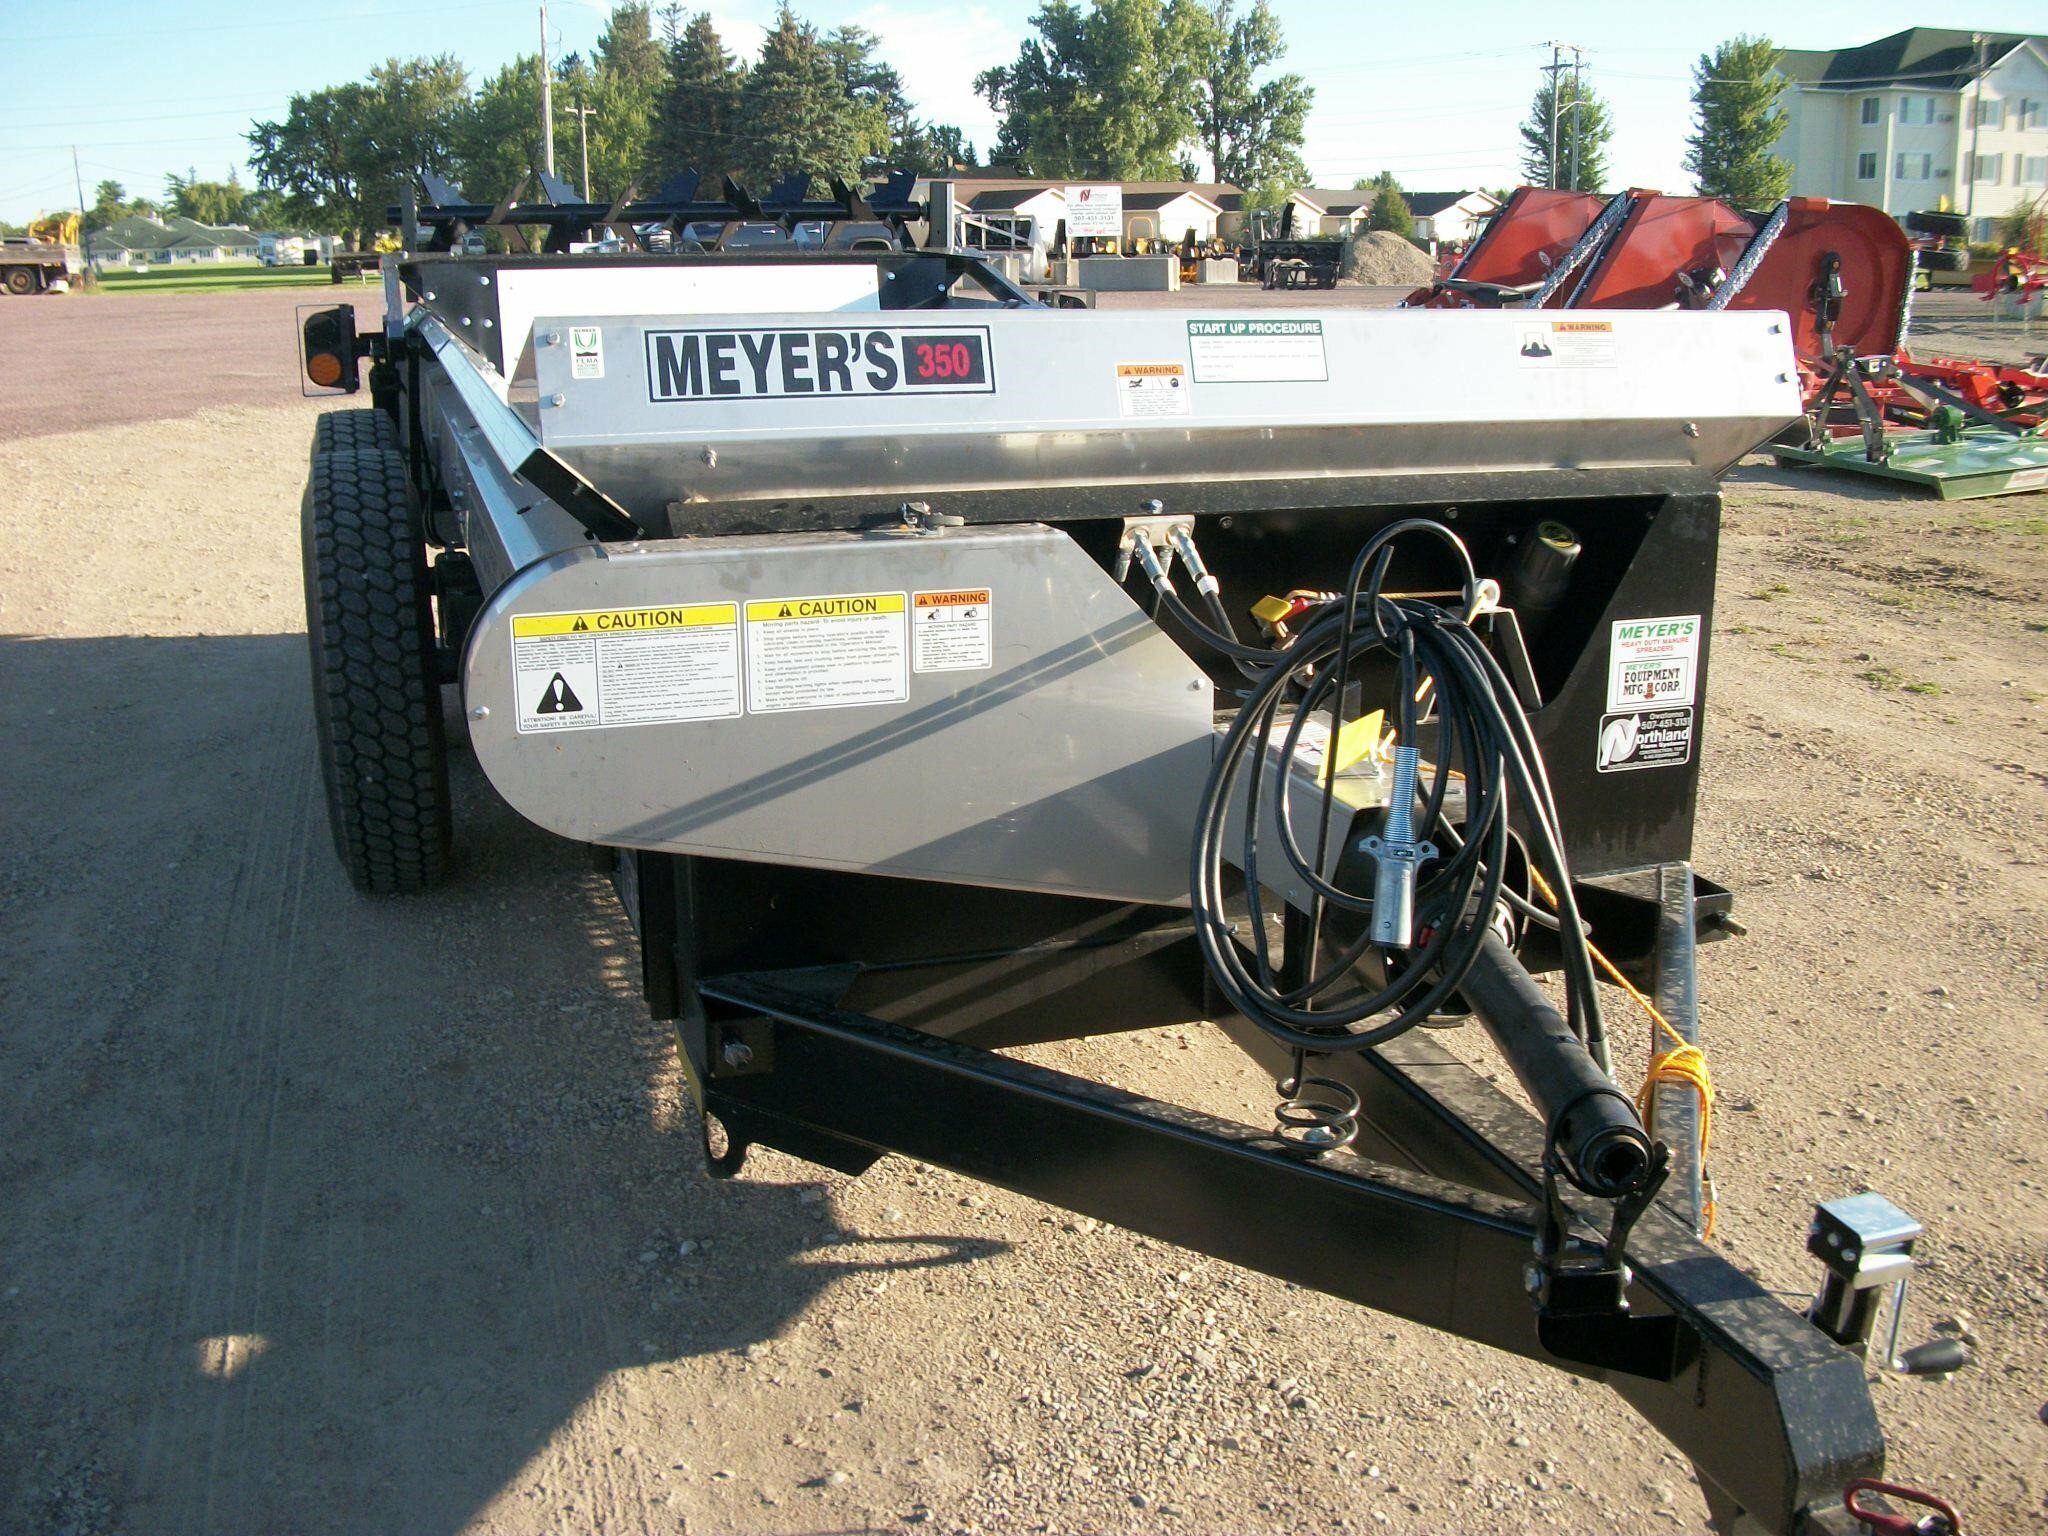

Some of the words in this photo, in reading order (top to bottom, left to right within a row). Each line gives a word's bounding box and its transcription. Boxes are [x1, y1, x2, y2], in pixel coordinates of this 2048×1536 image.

[1189, 323, 1227, 334] START
[1229, 323, 1246, 334] UP
[1248, 322, 1320, 334] PROCEDURE
[1567, 323, 1607, 331] WARNING
[655, 330, 899, 396] MEYER'S
[916, 342, 971, 379] 350
[1134, 366, 1179, 376] WARNING
[931, 593, 987, 605] WARNING
[799, 598, 877, 617] CAUTION
[597, 610, 683, 630] CAUTION
[1618, 622, 1694, 639] MEYER'S
[1621, 640, 1641, 648] HEAVY
[1636, 645, 1674, 653] SPREADERS
[1624, 667, 1681, 683] EQUIPMENT
[1622, 683, 1646, 696] MFG.
[1655, 680, 1681, 692] CORP.
[1641, 717, 1690, 730] 507-451-3131
